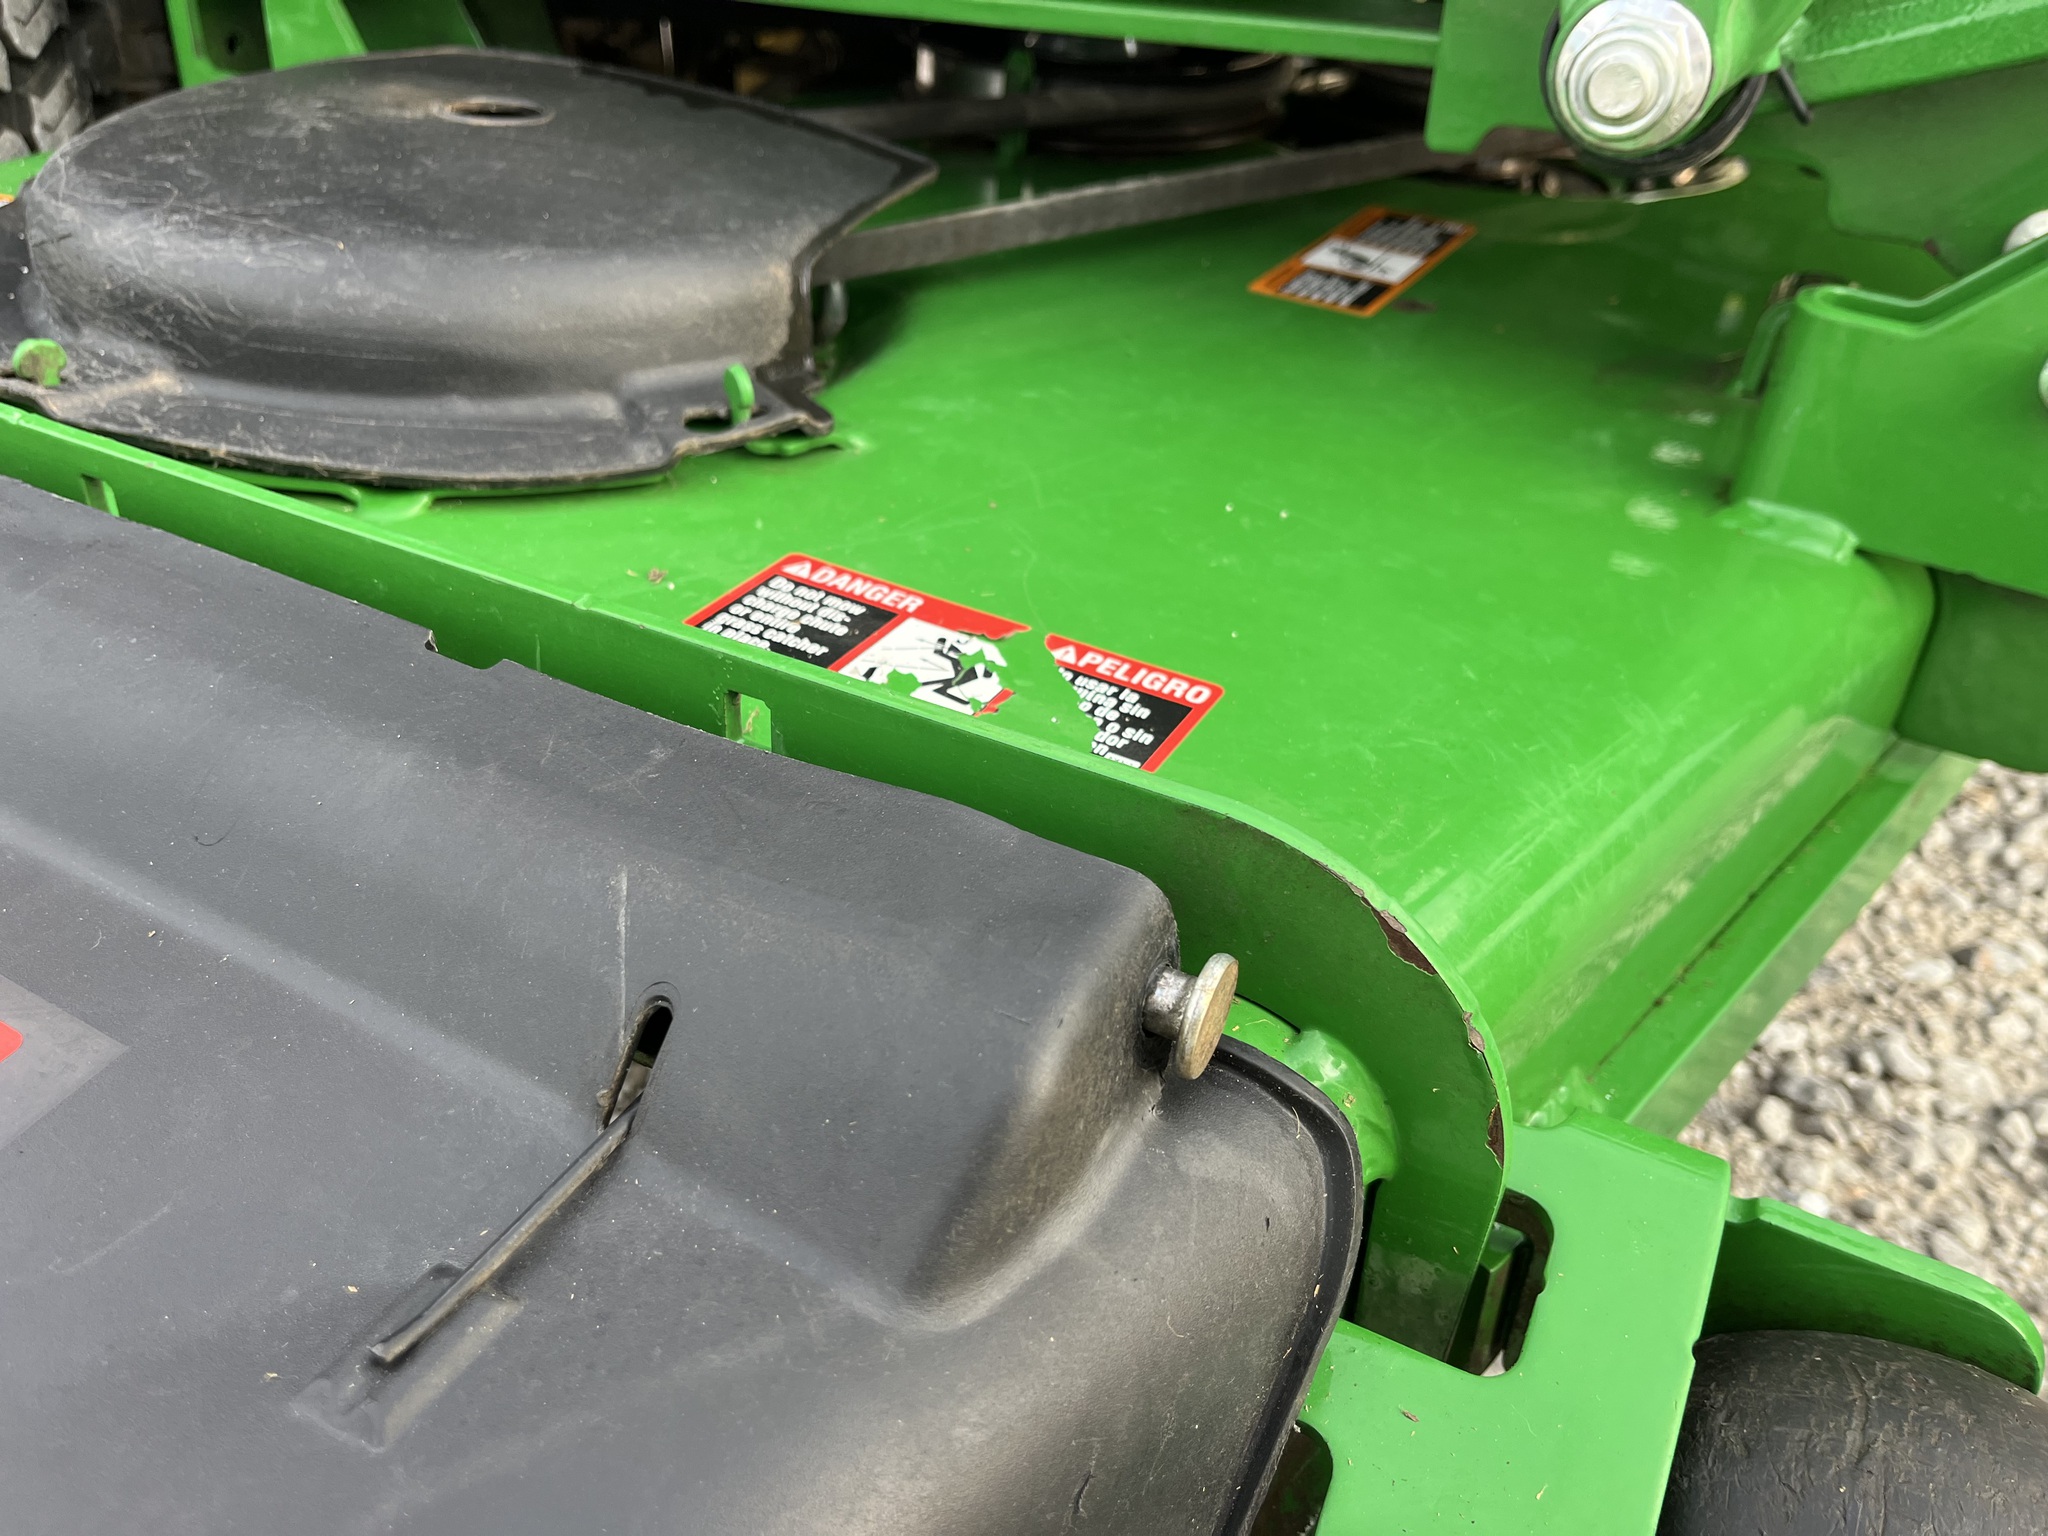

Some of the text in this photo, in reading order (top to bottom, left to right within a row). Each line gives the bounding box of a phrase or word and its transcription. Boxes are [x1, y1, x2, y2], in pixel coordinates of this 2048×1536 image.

[756, 585, 820, 613] without
[768, 576, 867, 615] Do not mow
[809, 566, 924, 613] DANGER
[728, 603, 801, 633] or entire
[742, 594, 849, 636] charge chute
[711, 612, 829, 656] grass catcher
[1074, 675, 1119, 696] usar
[1119, 688, 1140, 704] la
[1077, 651, 1212, 704] PELIGRO
[1094, 705, 1120, 721] de
[1119, 702, 1151, 719] sin
[1105, 722, 1154, 745] o sin
